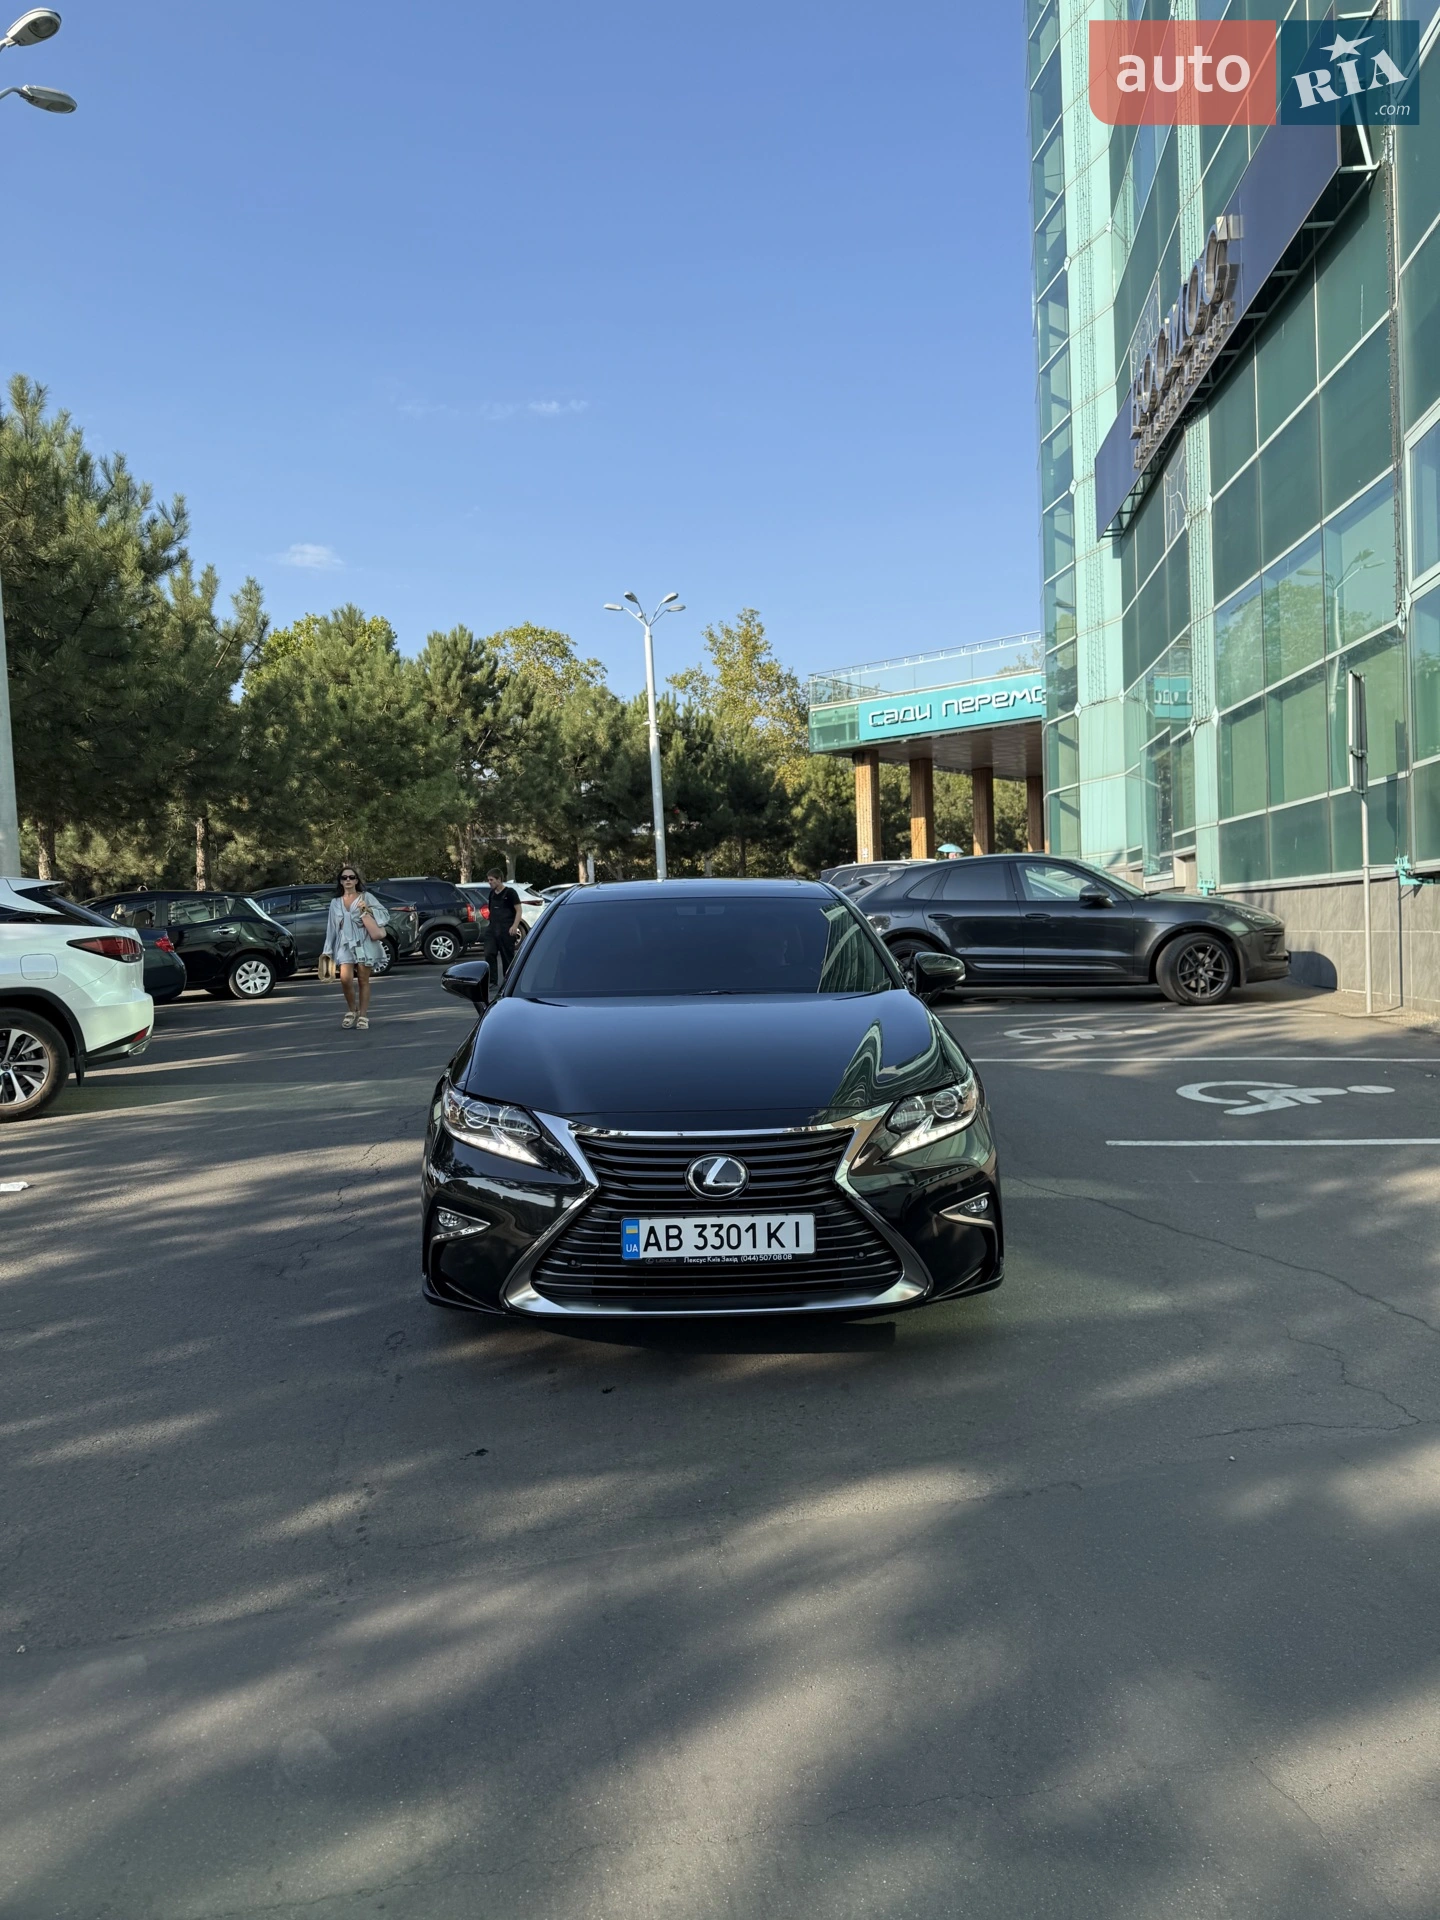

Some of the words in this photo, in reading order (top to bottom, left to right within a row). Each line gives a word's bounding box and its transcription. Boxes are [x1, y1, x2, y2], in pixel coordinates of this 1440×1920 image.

[643, 1224, 683, 1252] AB
[693, 1223, 757, 1251] 3301
[766, 1221, 800, 1249] KI
[625, 1244, 639, 1253] UA
[740, 1254, 758, 1262] (044)
